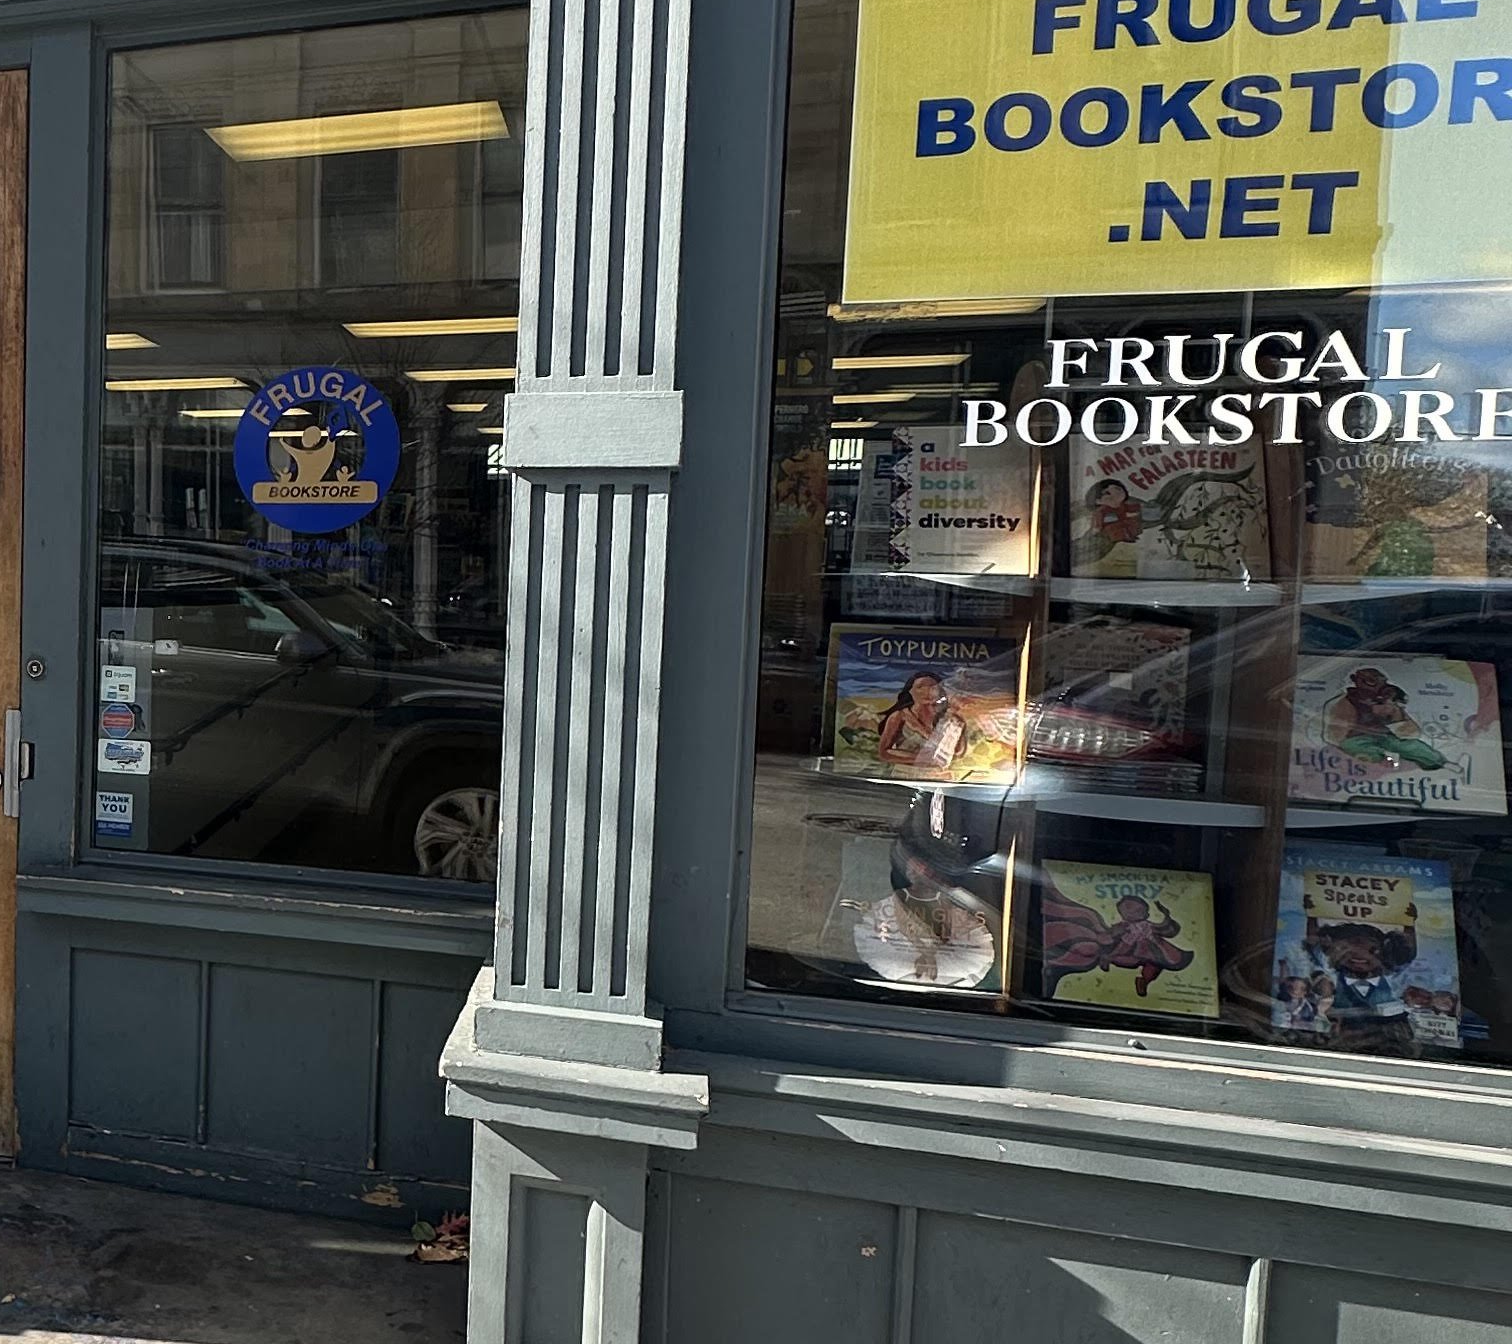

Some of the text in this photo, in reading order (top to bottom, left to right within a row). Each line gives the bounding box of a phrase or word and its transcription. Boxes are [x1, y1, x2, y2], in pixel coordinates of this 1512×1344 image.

[1107, 171, 1359, 243] .NET
[1043, 328, 1442, 388] FRUGAL
[249, 371, 384, 426] FRUGAL
[958, 386, 1512, 448] BOOKSTORE
[920, 441, 935, 453] a
[920, 456, 968, 472] kids
[1096, 446, 1137, 476] MAP
[1127, 450, 1237, 491] FALASTEEN
[268, 485, 361, 498] BOOKSTORE
[920, 476, 976, 491] book
[919, 494, 985, 511] about
[918, 513, 1021, 532] diversity
[858, 637, 990, 659] TOYPURINA
[1294, 747, 1339, 773] Life
[1324, 772, 1461, 805] Beautiful
[99, 794, 130, 803] THANK
[102, 803, 127, 813] YOU
[1095, 883, 1165, 900] STORY
[1316, 874, 1400, 892] STACEY
[1324, 888, 1388, 906] Speaks
[1343, 905, 1373, 918] UP
